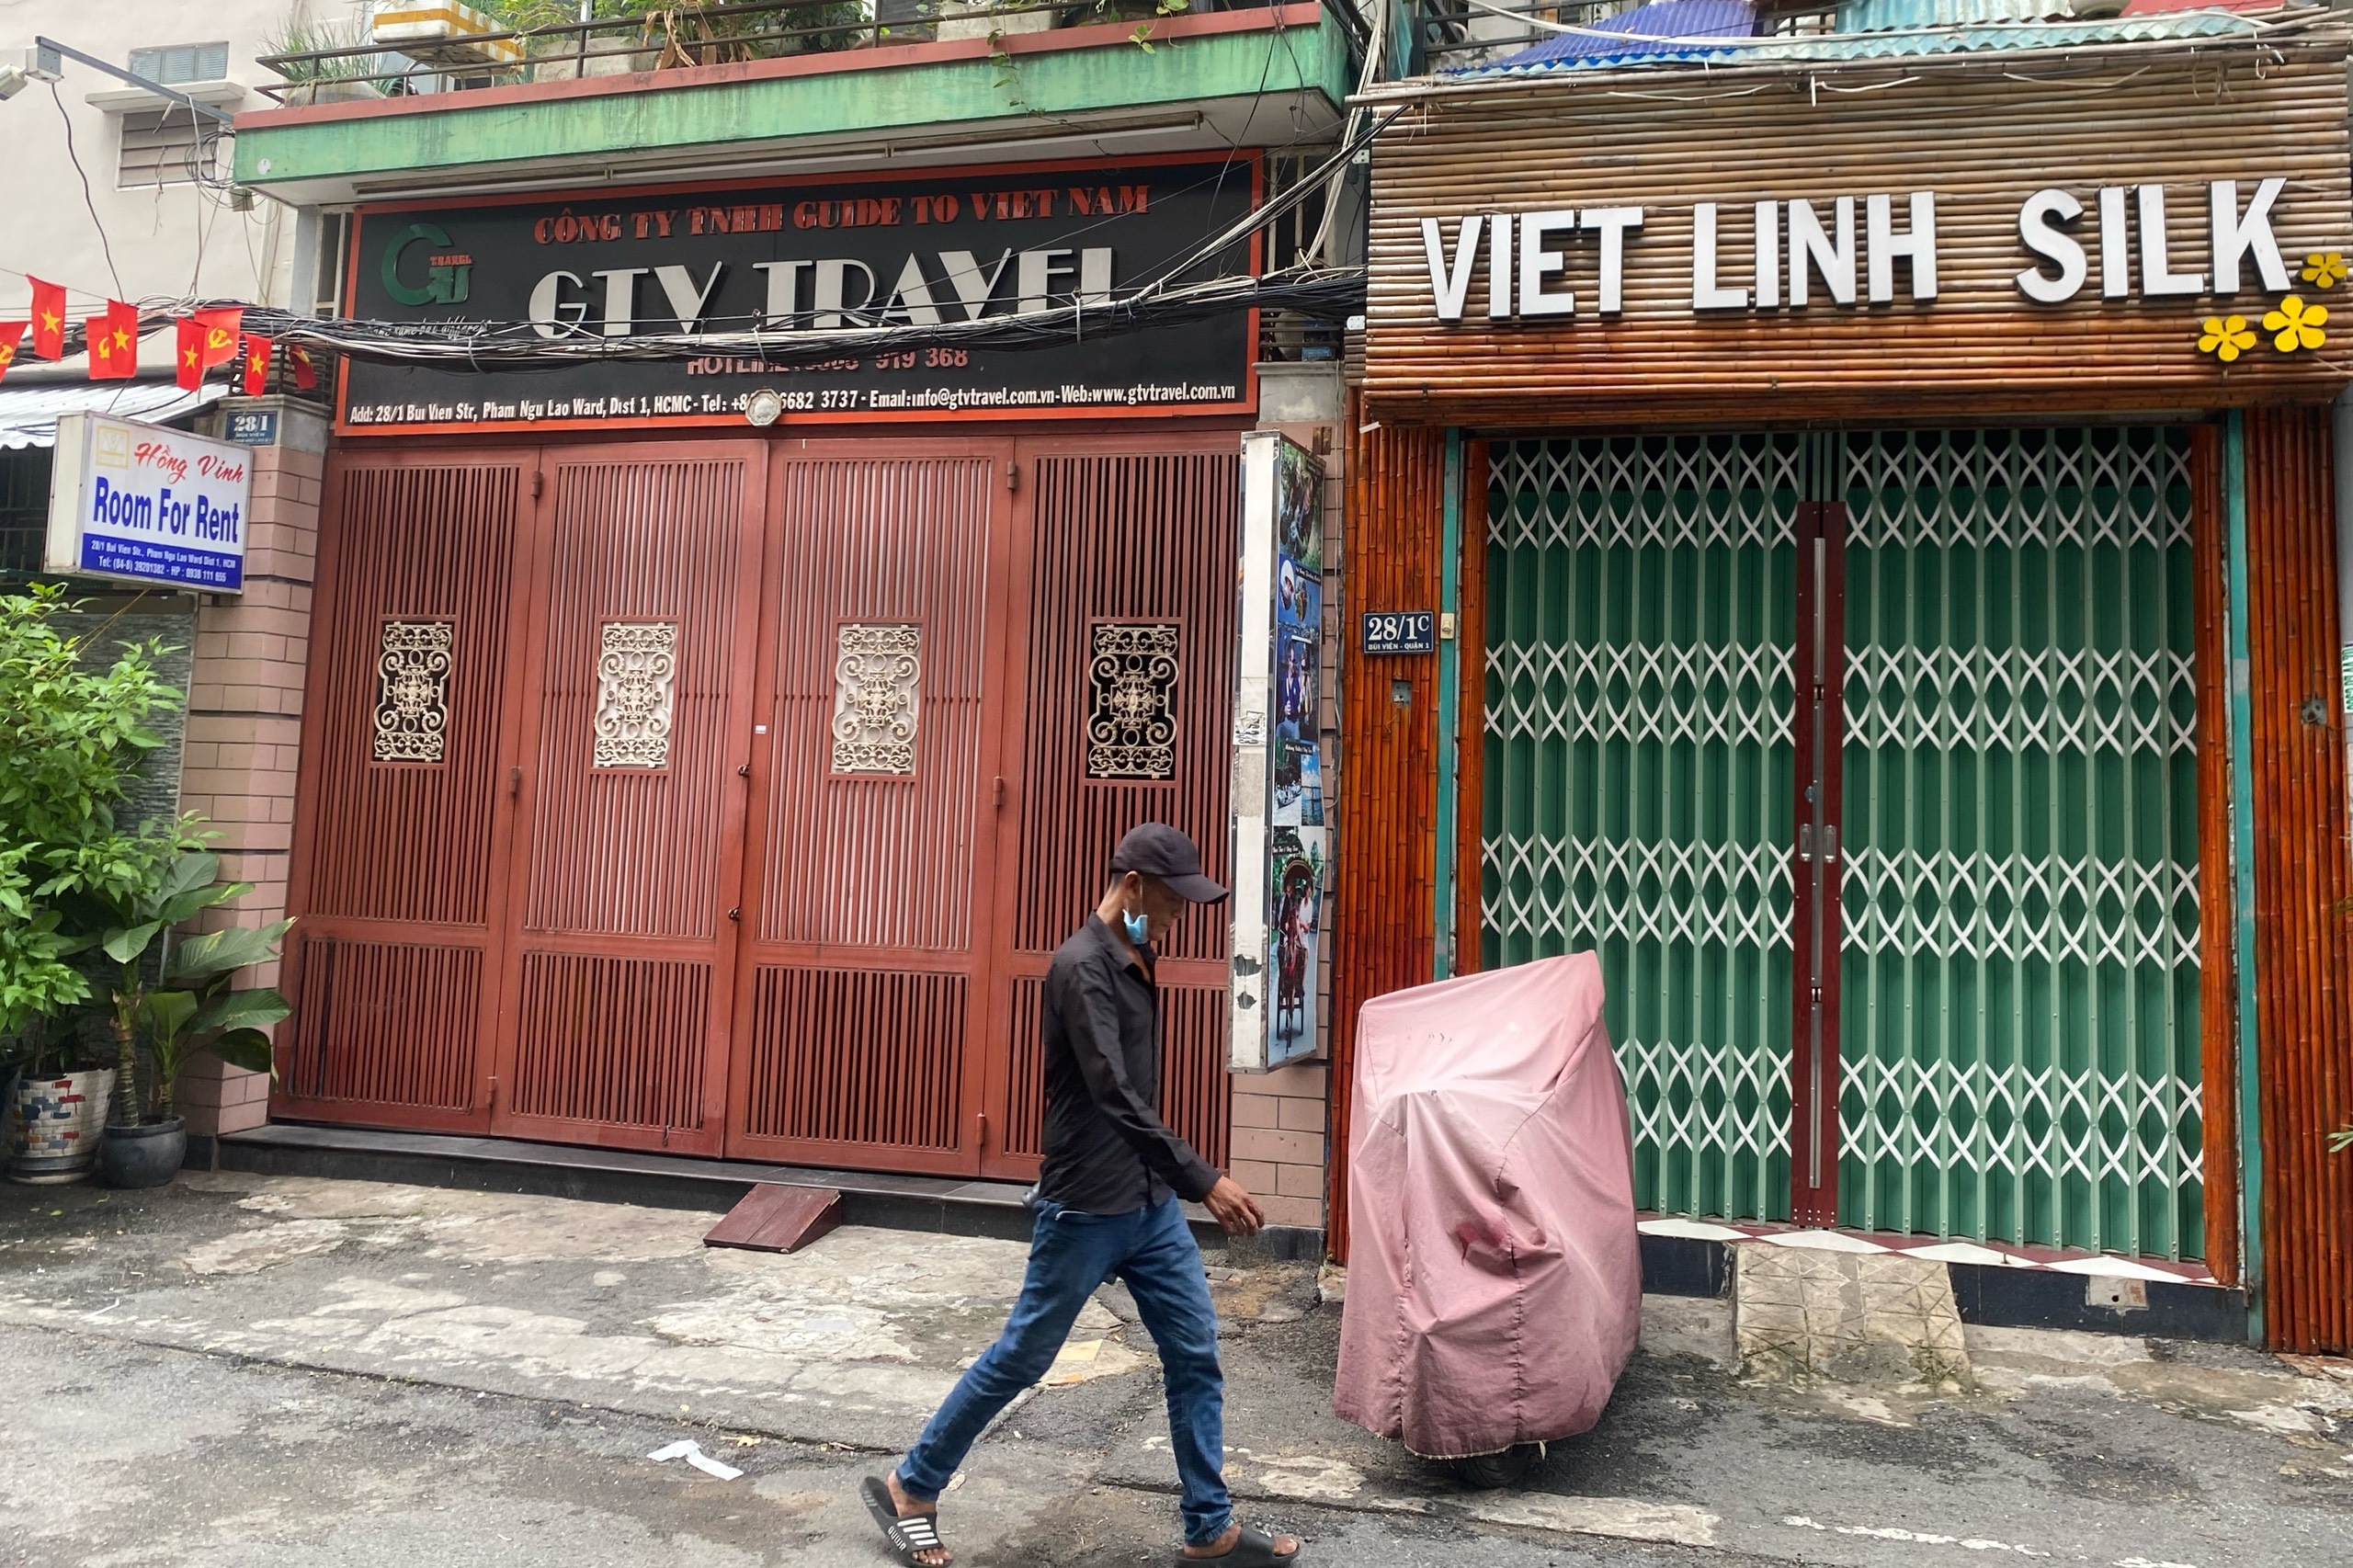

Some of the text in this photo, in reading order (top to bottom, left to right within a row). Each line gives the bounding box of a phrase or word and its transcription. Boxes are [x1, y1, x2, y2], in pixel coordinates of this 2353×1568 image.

[535, 186, 1150, 244] CÔNG TY TNHH GUIDE TO VIET NAM
[1421, 177, 2292, 322] VIET LINH SILK
[529, 260, 723, 340] GTV
[925, 347, 968, 368] 368
[233, 415, 268, 432] 28/1
[349, 405, 373, 423] Add:
[375, 404, 404, 423] 28/1
[456, 402, 478, 422] Str,
[483, 401, 515, 419] Pham
[520, 400, 543, 420] Ngu
[548, 400, 569, 416] Lao
[573, 398, 607, 418] Ward,
[640, 396, 651, 416] 1,
[701, 394, 727, 412] Tel:
[821, 390, 858, 408] 3737
[134, 443, 188, 484] Hồng
[93, 476, 239, 543] Room For Rent
[91, 540, 105, 551] 28/1
[146, 548, 163, 559] Pham
[176, 552, 187, 562] Lao
[188, 553, 203, 564] Ward
[98, 556, 111, 567] Tel:
[171, 566, 181, 576] HP
[202, 571, 213, 580] 111
